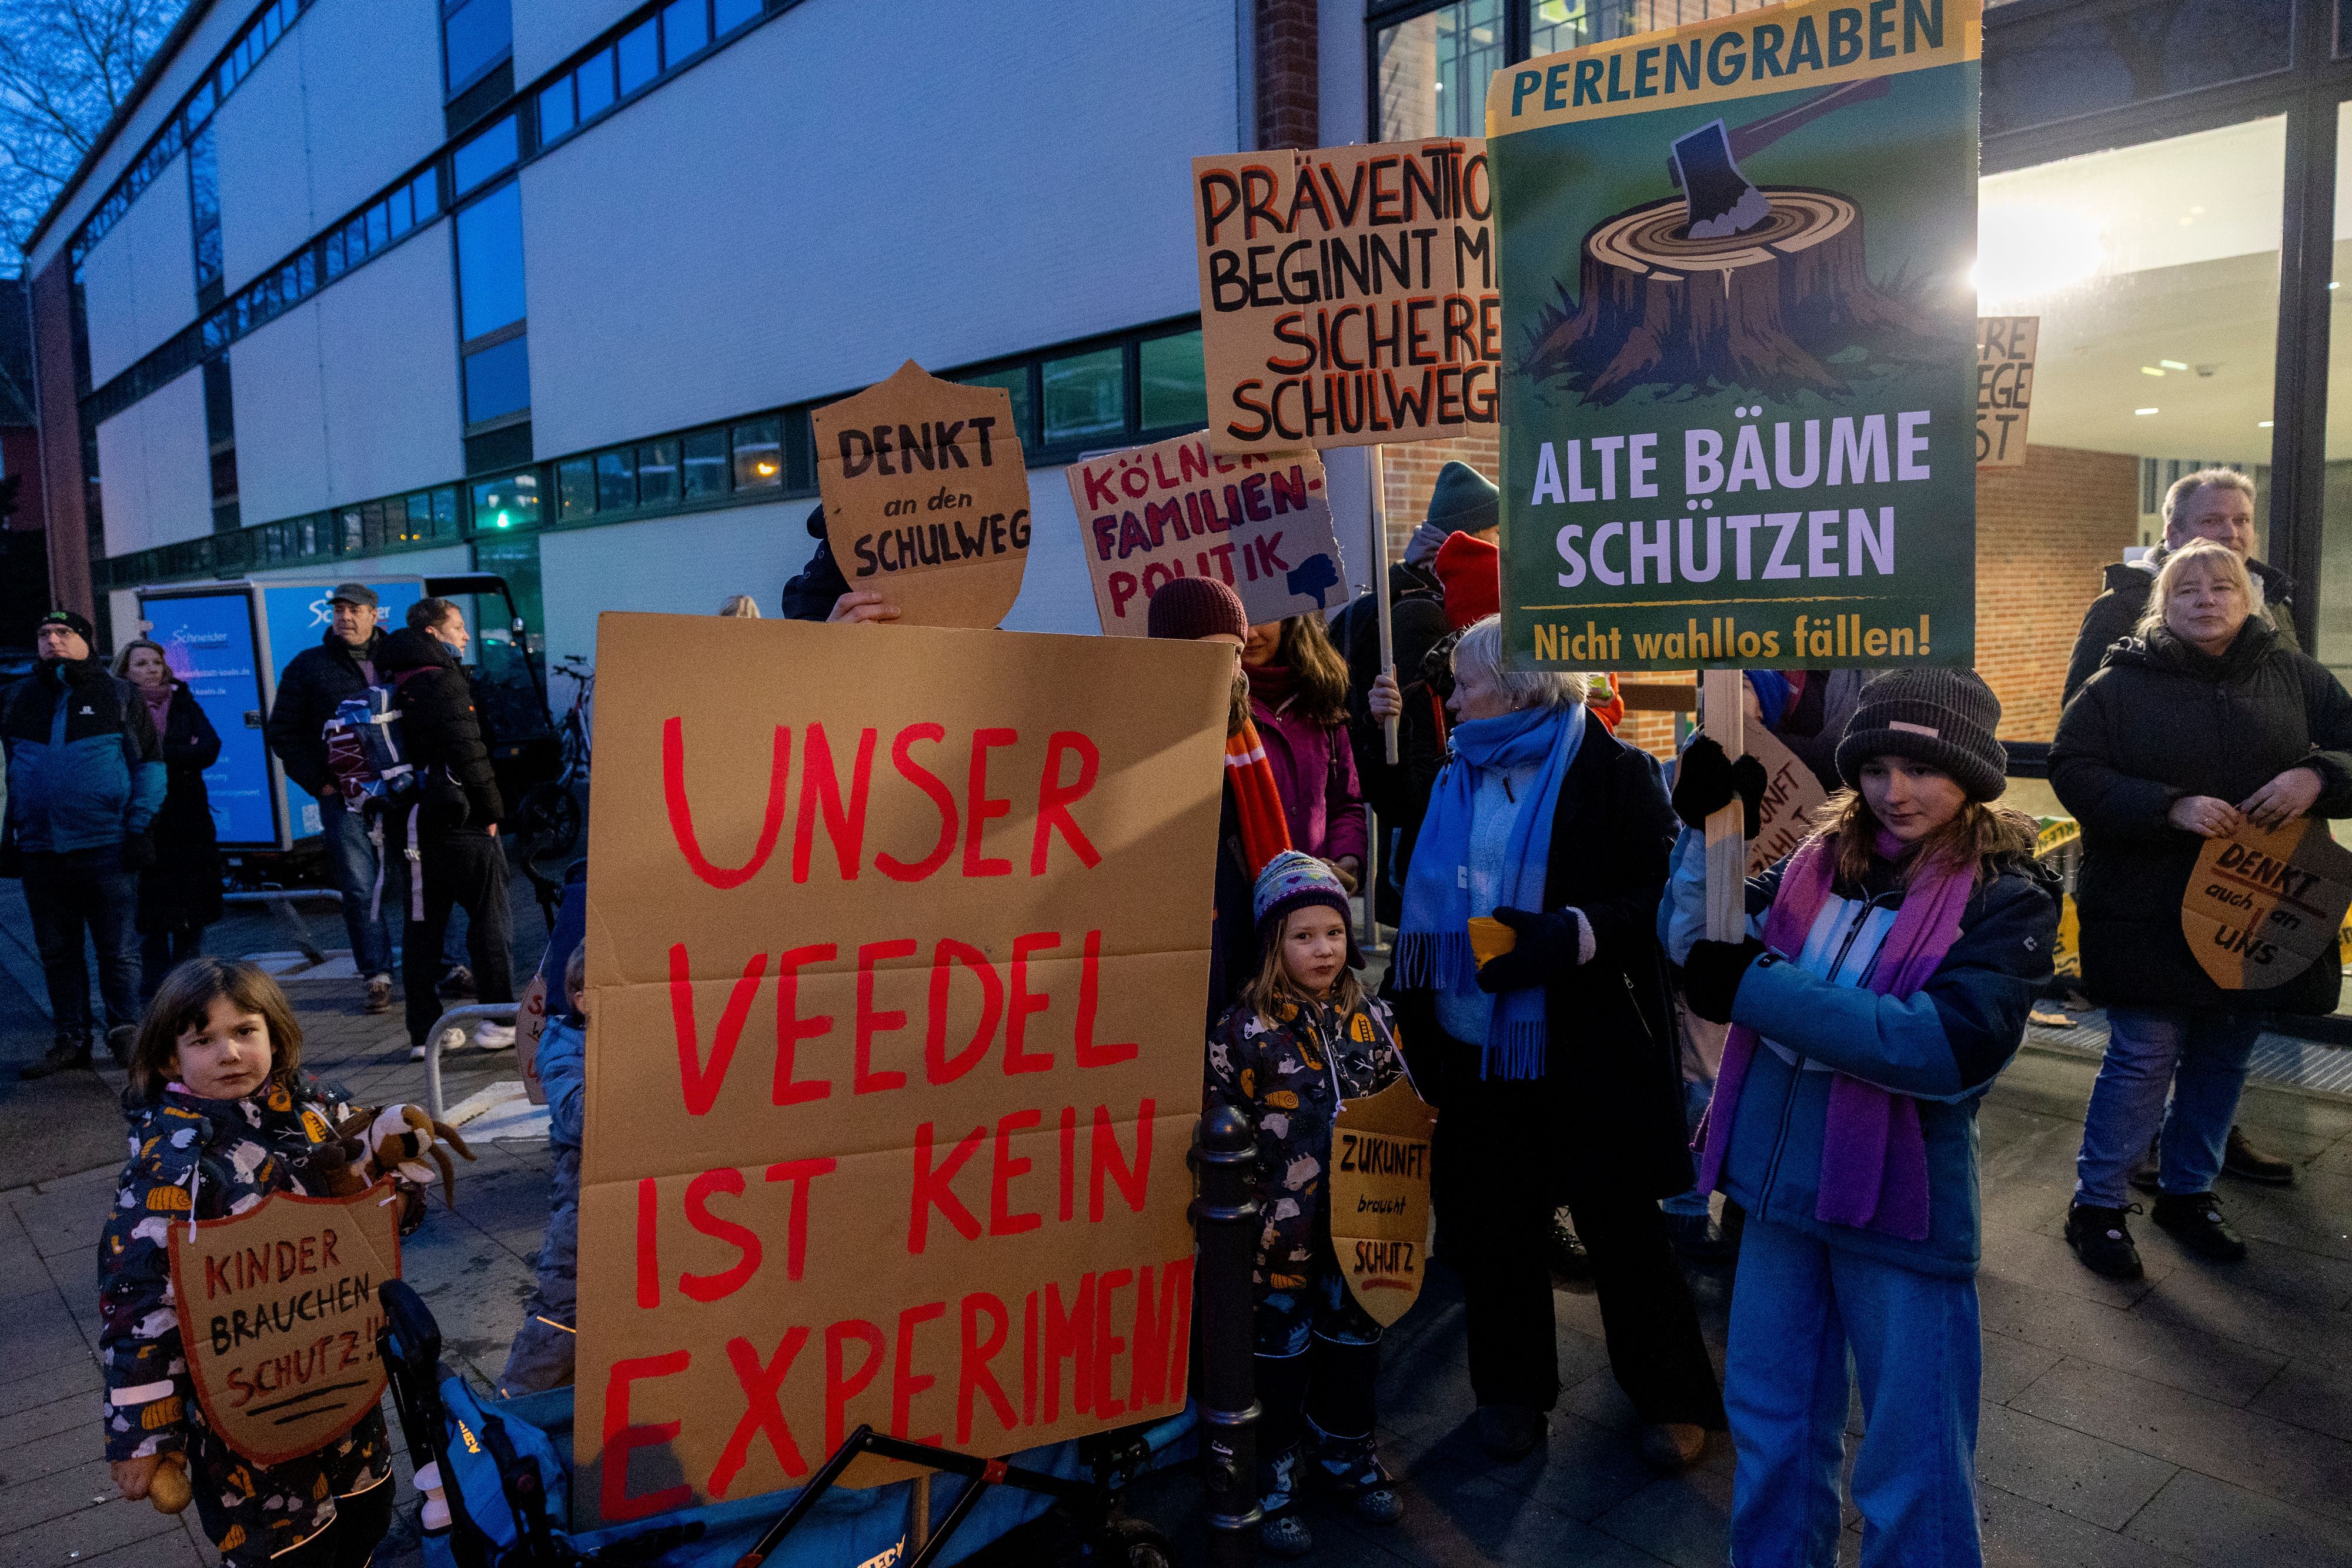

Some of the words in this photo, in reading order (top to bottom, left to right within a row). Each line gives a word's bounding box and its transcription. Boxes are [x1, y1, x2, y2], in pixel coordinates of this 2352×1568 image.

[1511, 0, 1945, 117] PERLENGRABEN
[1210, 228, 1438, 313] BEGINNT
[1455, 226, 1499, 289] M
[1266, 294, 1501, 375] SICHERE
[1977, 319, 2029, 360] RE
[1227, 362, 1500, 441] SCHULWEG
[838, 416, 995, 479] DENKT
[1531, 433, 1659, 506] ALTE
[1685, 406, 1931, 495] BÄUME
[884, 499, 917, 516] an
[928, 486, 972, 511] den
[1093, 465, 1322, 561] FAMILIEN-
[854, 509, 1031, 577] SCHULWEG
[1556, 499, 1895, 588] SCHÜTZEN
[1535, 621, 1621, 660] Nicht
[1632, 617, 1779, 659] wahllos
[1793, 614, 1931, 657] fällen!
[662, 716, 1102, 890] UNSER
[1760, 760, 1799, 824] UNFT
[2216, 842, 2320, 898] DENKT
[2205, 884, 2253, 910] auch
[2269, 910, 2301, 930] an
[2214, 924, 2278, 965] UNS
[669, 930, 1139, 1115] VEEDEL
[1340, 1134, 1427, 1179] ZUKUNFT
[637, 1156, 837, 1309] IST
[907, 1098, 1155, 1255] KEIN
[1358, 1193, 1405, 1216] braucht
[205, 1229, 340, 1300] KINDER
[1354, 1240, 1415, 1275] SCHUTZ
[210, 1272, 370, 1356] BRAUCHEN
[600, 1255, 1195, 1521] EXPERIMENT
[857, 1547, 897, 1568] TEC
